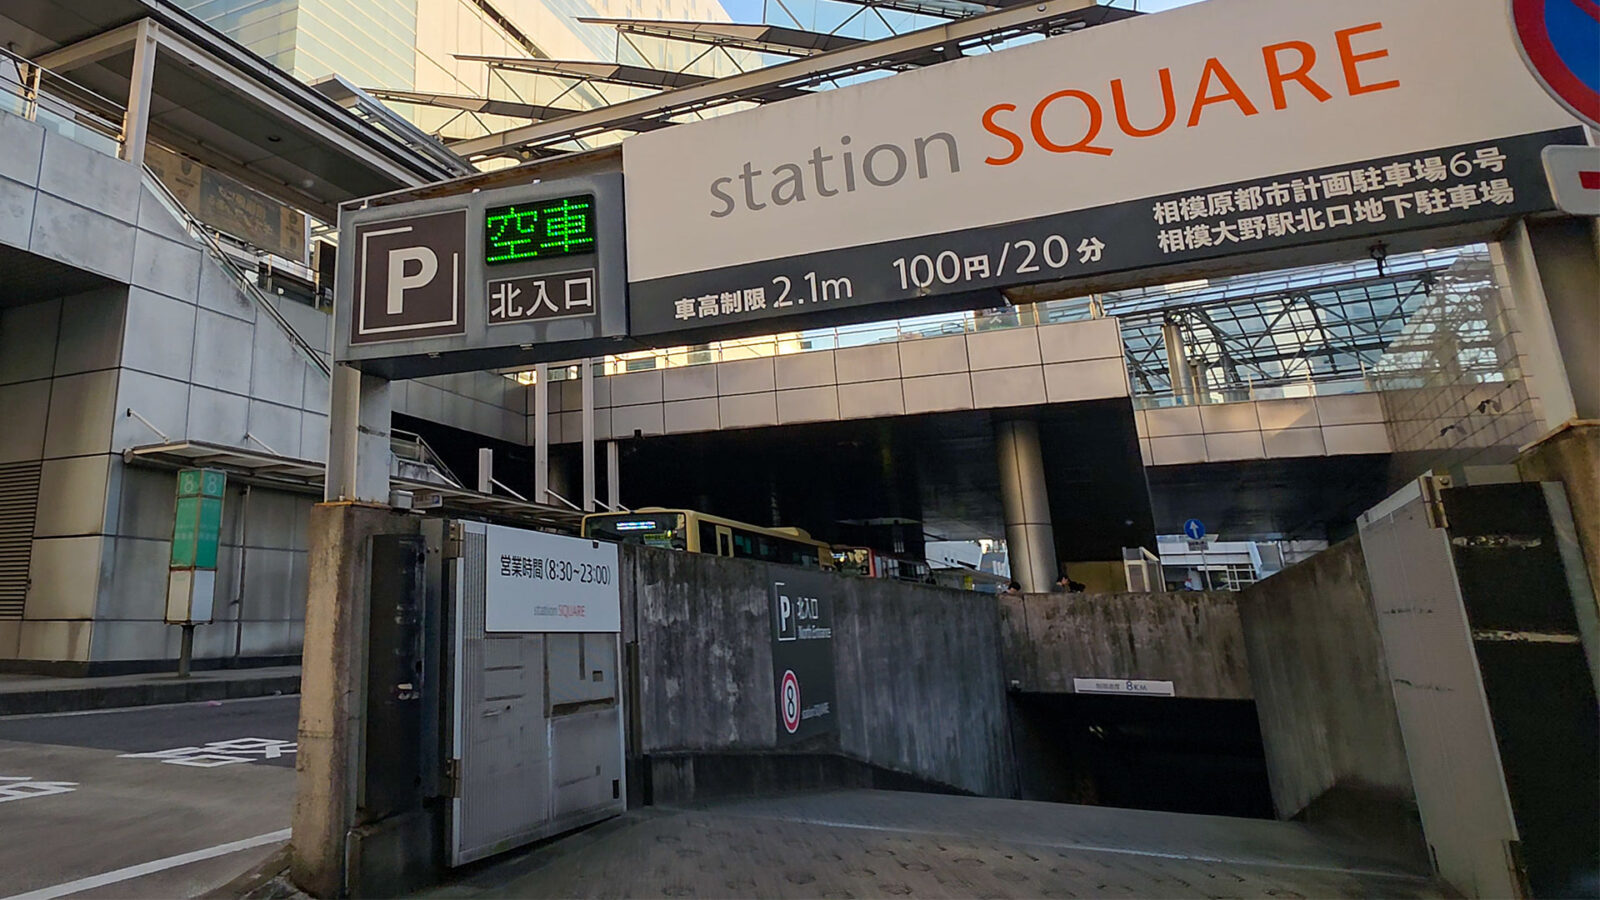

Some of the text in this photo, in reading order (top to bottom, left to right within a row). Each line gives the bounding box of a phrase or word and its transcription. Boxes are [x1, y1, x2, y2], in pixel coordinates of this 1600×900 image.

[710, 22, 1400, 219] station SQUARE
[1153, 146, 1507, 226] 相模原都市計画駐車場6号
[487, 199, 593, 261] 空車
[1157, 178, 1515, 253] 相模大野駅北口地下駐車場
[386, 246, 437, 315] P
[491, 277, 593, 319] 北入口
[558, 604, 585, 618] SQUARE
[780, 595, 791, 632] P
[796, 596, 819, 620] 北入口
[787, 685, 795, 718] 8
